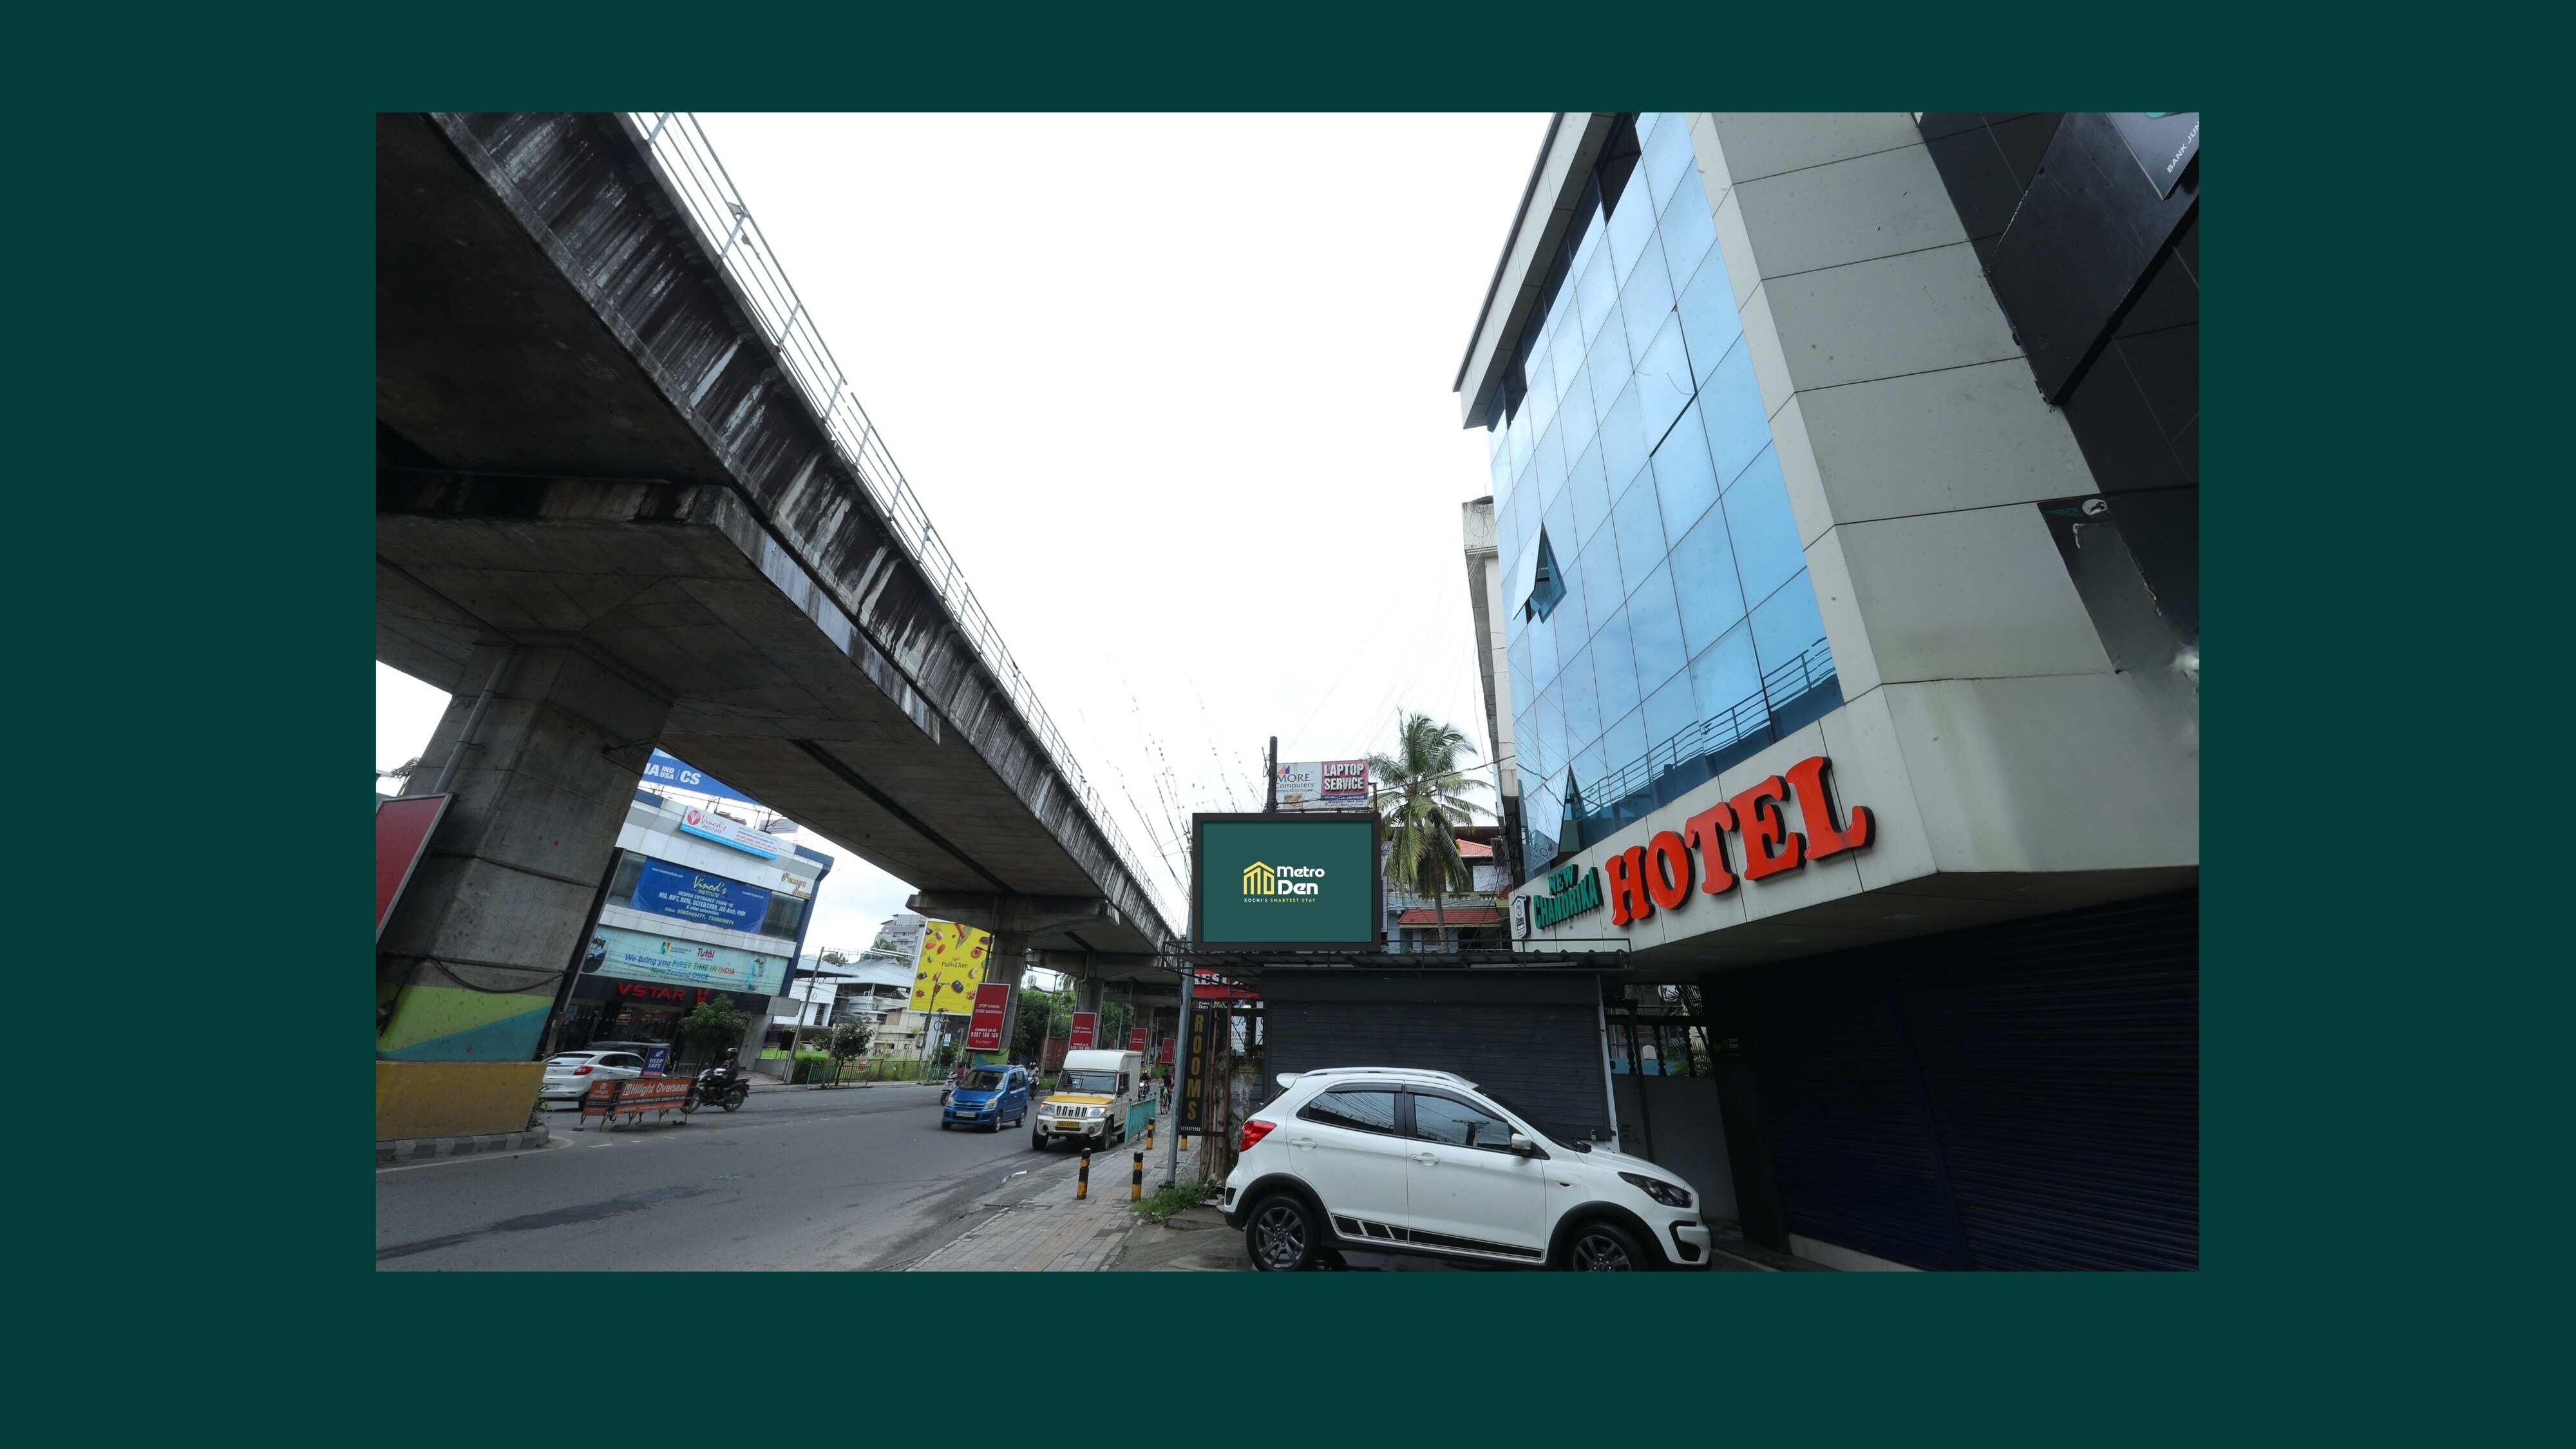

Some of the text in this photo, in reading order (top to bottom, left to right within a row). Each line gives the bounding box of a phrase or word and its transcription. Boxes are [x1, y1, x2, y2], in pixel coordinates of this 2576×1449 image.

[2167, 142, 2188, 173] BANK
[659, 771, 674, 780] USA
[679, 770, 701, 785] CS
[1324, 763, 1364, 777] LAPTOP
[1324, 777, 1364, 791] SERVICE
[701, 824, 723, 834] INSTITUTE
[1605, 756, 1875, 925] HOTEL
[1277, 866, 1325, 877] Metro
[694, 875, 728, 895] Vinod's
[1278, 880, 1318, 895] Den
[1548, 864, 1578, 896] NEW
[694, 895, 715, 904] ENTRANCE
[697, 889, 720, 898] INSTITUTE
[1533, 866, 1603, 929] CHANDRIKA
[638, 956, 657, 966] bring
[672, 960, 692, 969] FIRST
[693, 963, 709, 972] TIME
[718, 966, 735, 975] INDIA
[667, 969, 691, 978] Zealand
[618, 983, 688, 1000] VSTAR
[1187, 1014, 1204, 1121] ROOMS
[630, 1083, 656, 1096] Hilight
[656, 1083, 688, 1093] Overseas
